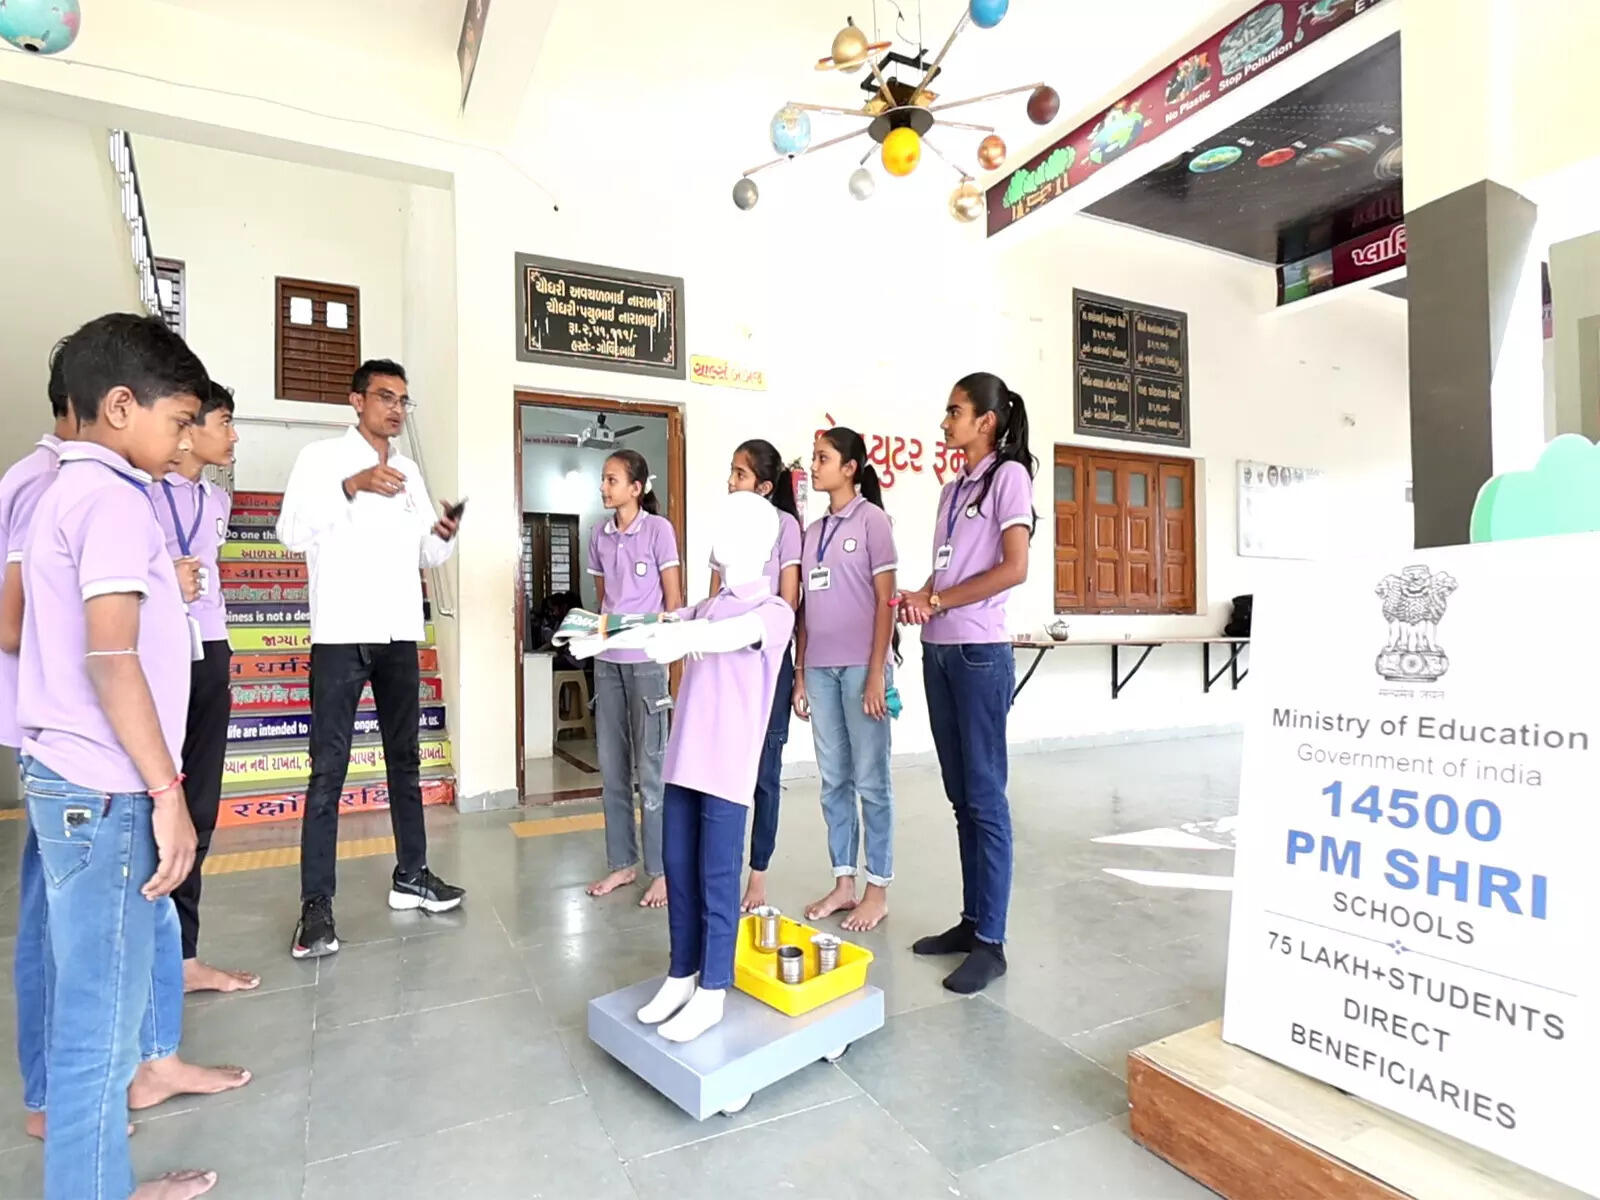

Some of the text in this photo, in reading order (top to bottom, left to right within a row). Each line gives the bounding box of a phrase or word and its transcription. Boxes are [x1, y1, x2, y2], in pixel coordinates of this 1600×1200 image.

[1218, 41, 1293, 92] Stop Pollution
[1165, 90, 1211, 123] No Plastic
[225, 530, 238, 538] Do
[263, 530, 280, 539] thi
[256, 610, 264, 622] is
[267, 611, 284, 621] not
[286, 612, 292, 621] a
[294, 610, 310, 621] des
[227, 724, 242, 739] life
[243, 726, 258, 738] are
[259, 721, 297, 737] intended
[299, 722, 308, 734] to
[354, 720, 379, 733] onger,
[1273, 708, 1589, 750] Ministry of Education
[1298, 743, 1433, 776] Government
[1443, 757, 1468, 778] of
[1322, 780, 1502, 842] 14500
[1287, 829, 1547, 920] PM SHRI
[1333, 891, 1474, 944] SCHOOLS
[1268, 930, 1564, 1041] 75 LAKH+STUDENTS
[1344, 997, 1450, 1053] DIRECT
[1292, 1022, 1516, 1130] BENEFICIARIES
